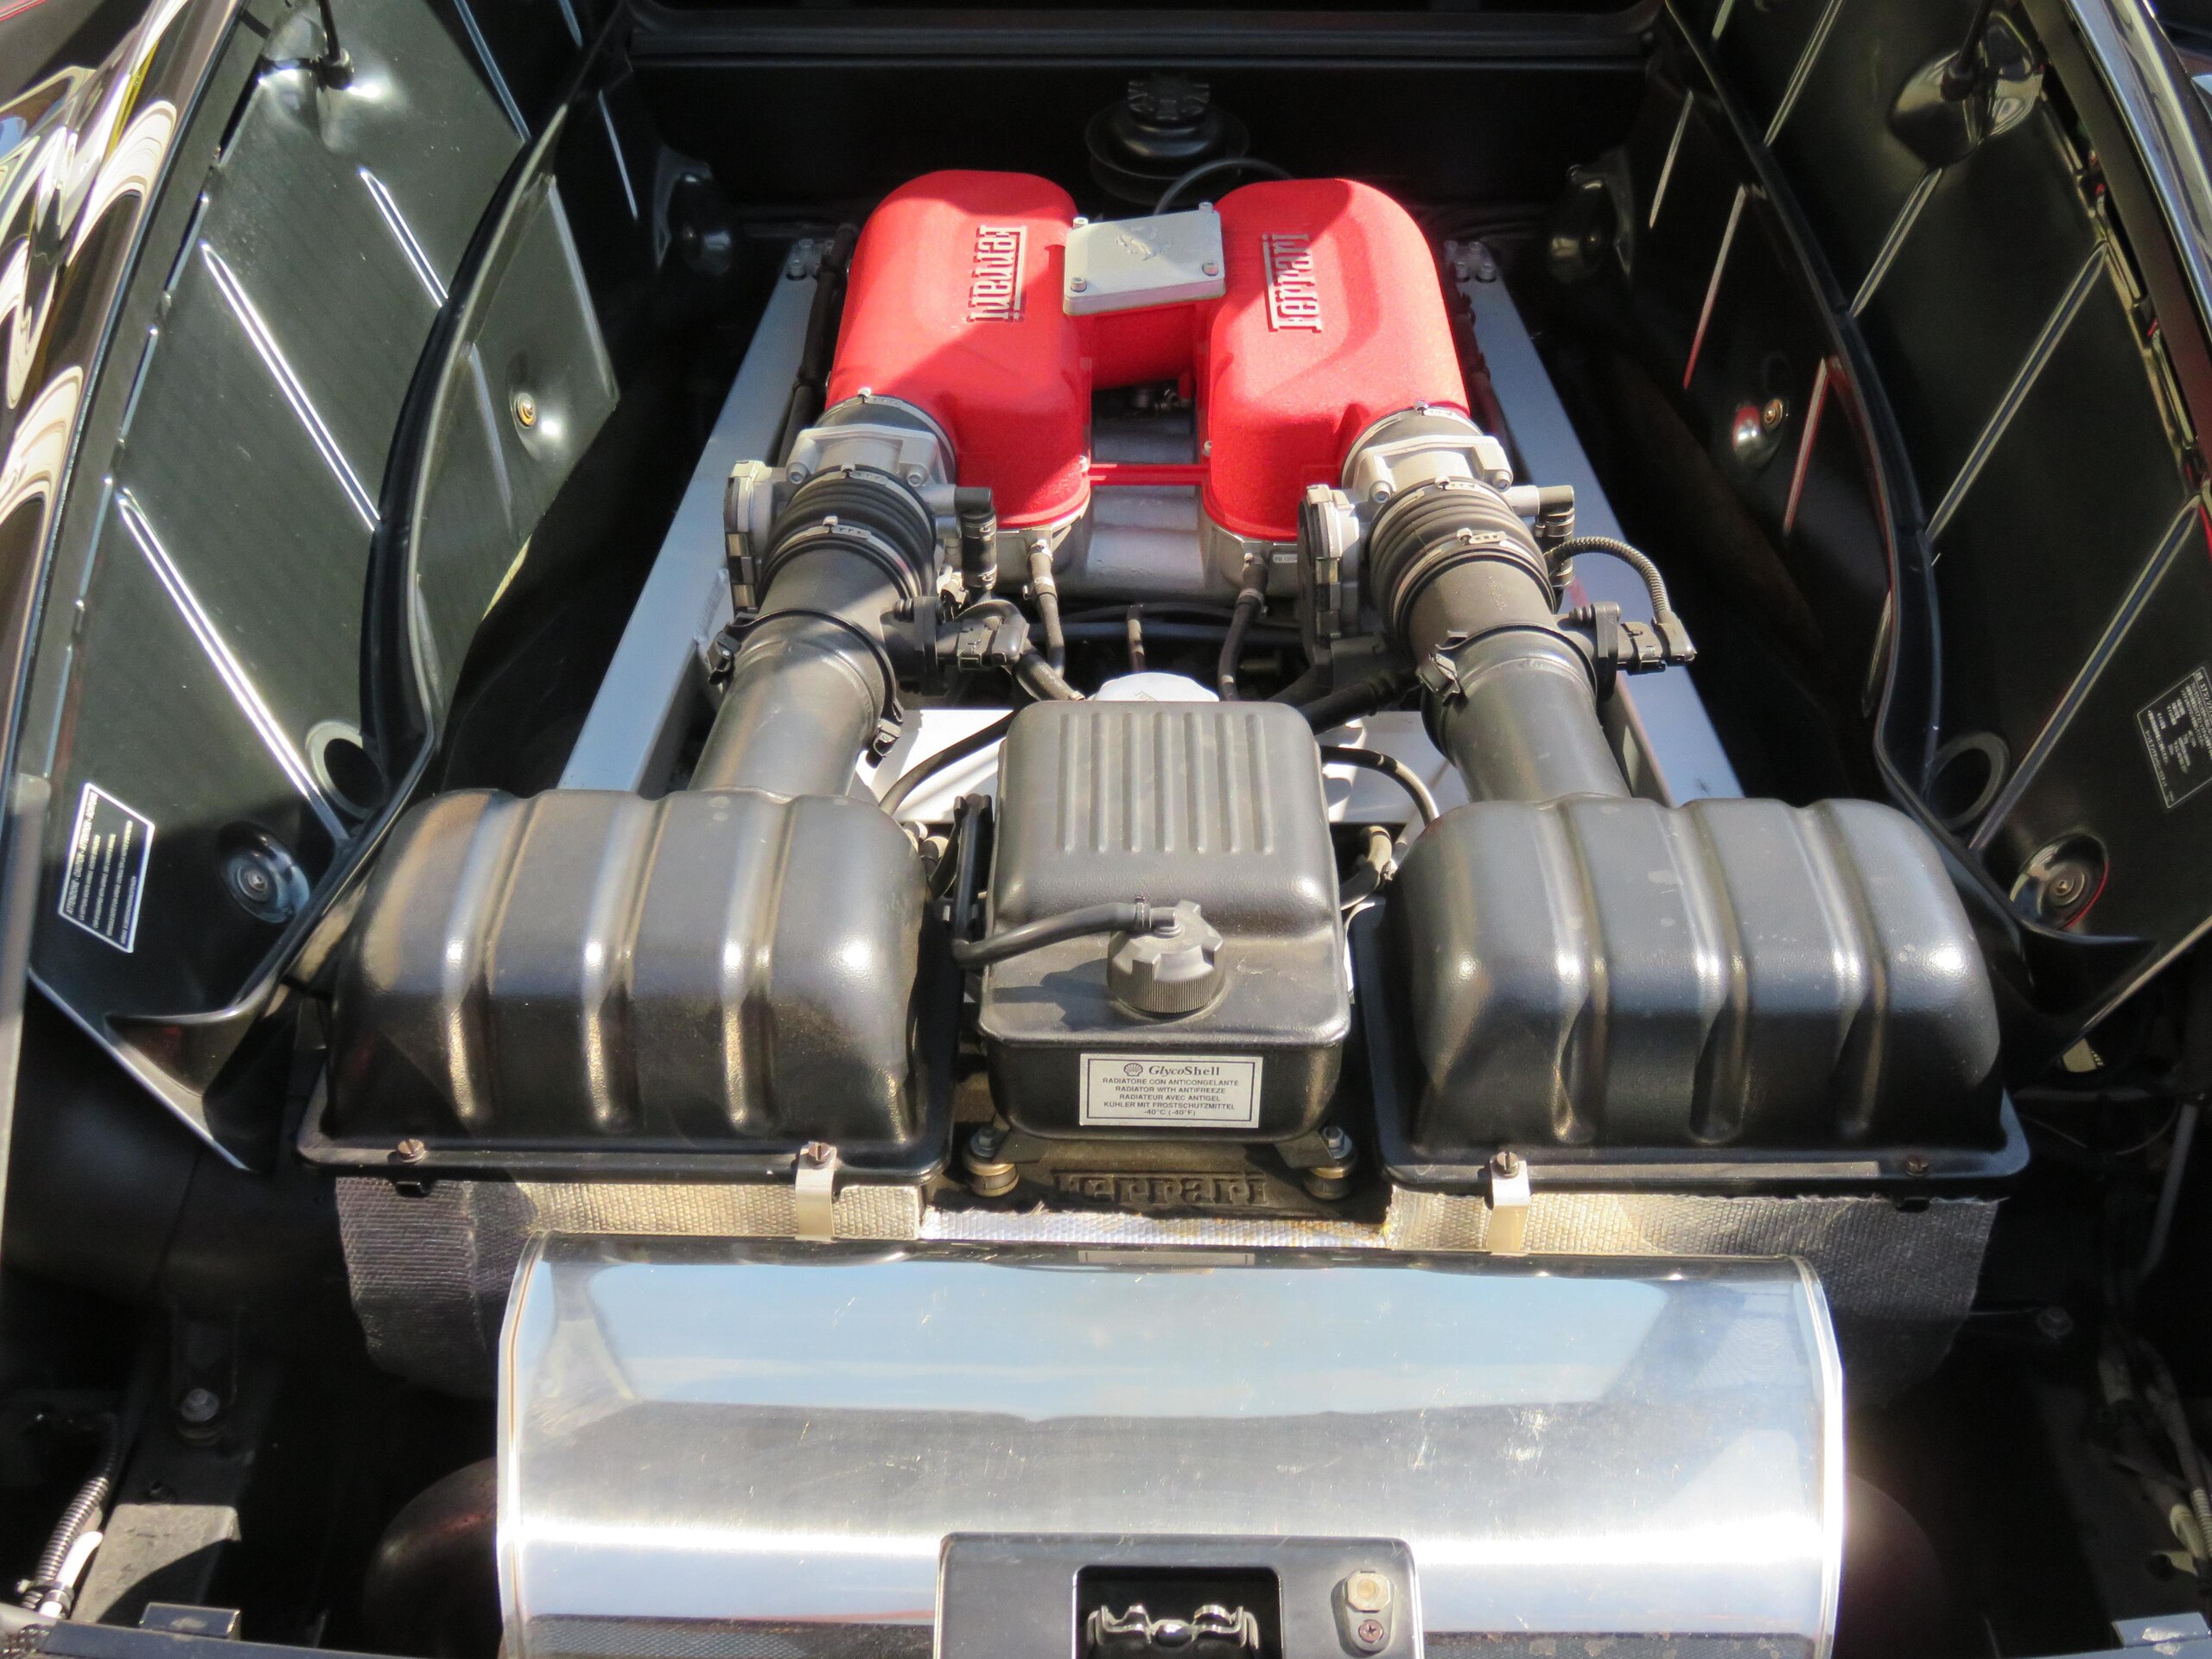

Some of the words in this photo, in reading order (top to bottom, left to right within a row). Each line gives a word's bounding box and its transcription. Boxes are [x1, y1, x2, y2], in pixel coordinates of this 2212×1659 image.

[968, 224, 1027, 321] Ferrari
[1262, 233, 1323, 332] Ferrari
[1148, 1065, 1220, 1077] GlycoShell
[1152, 1102, 1236, 1110] FROSTSCHUTZMITTEL
[1051, 1168, 1271, 1206] Ferrari
